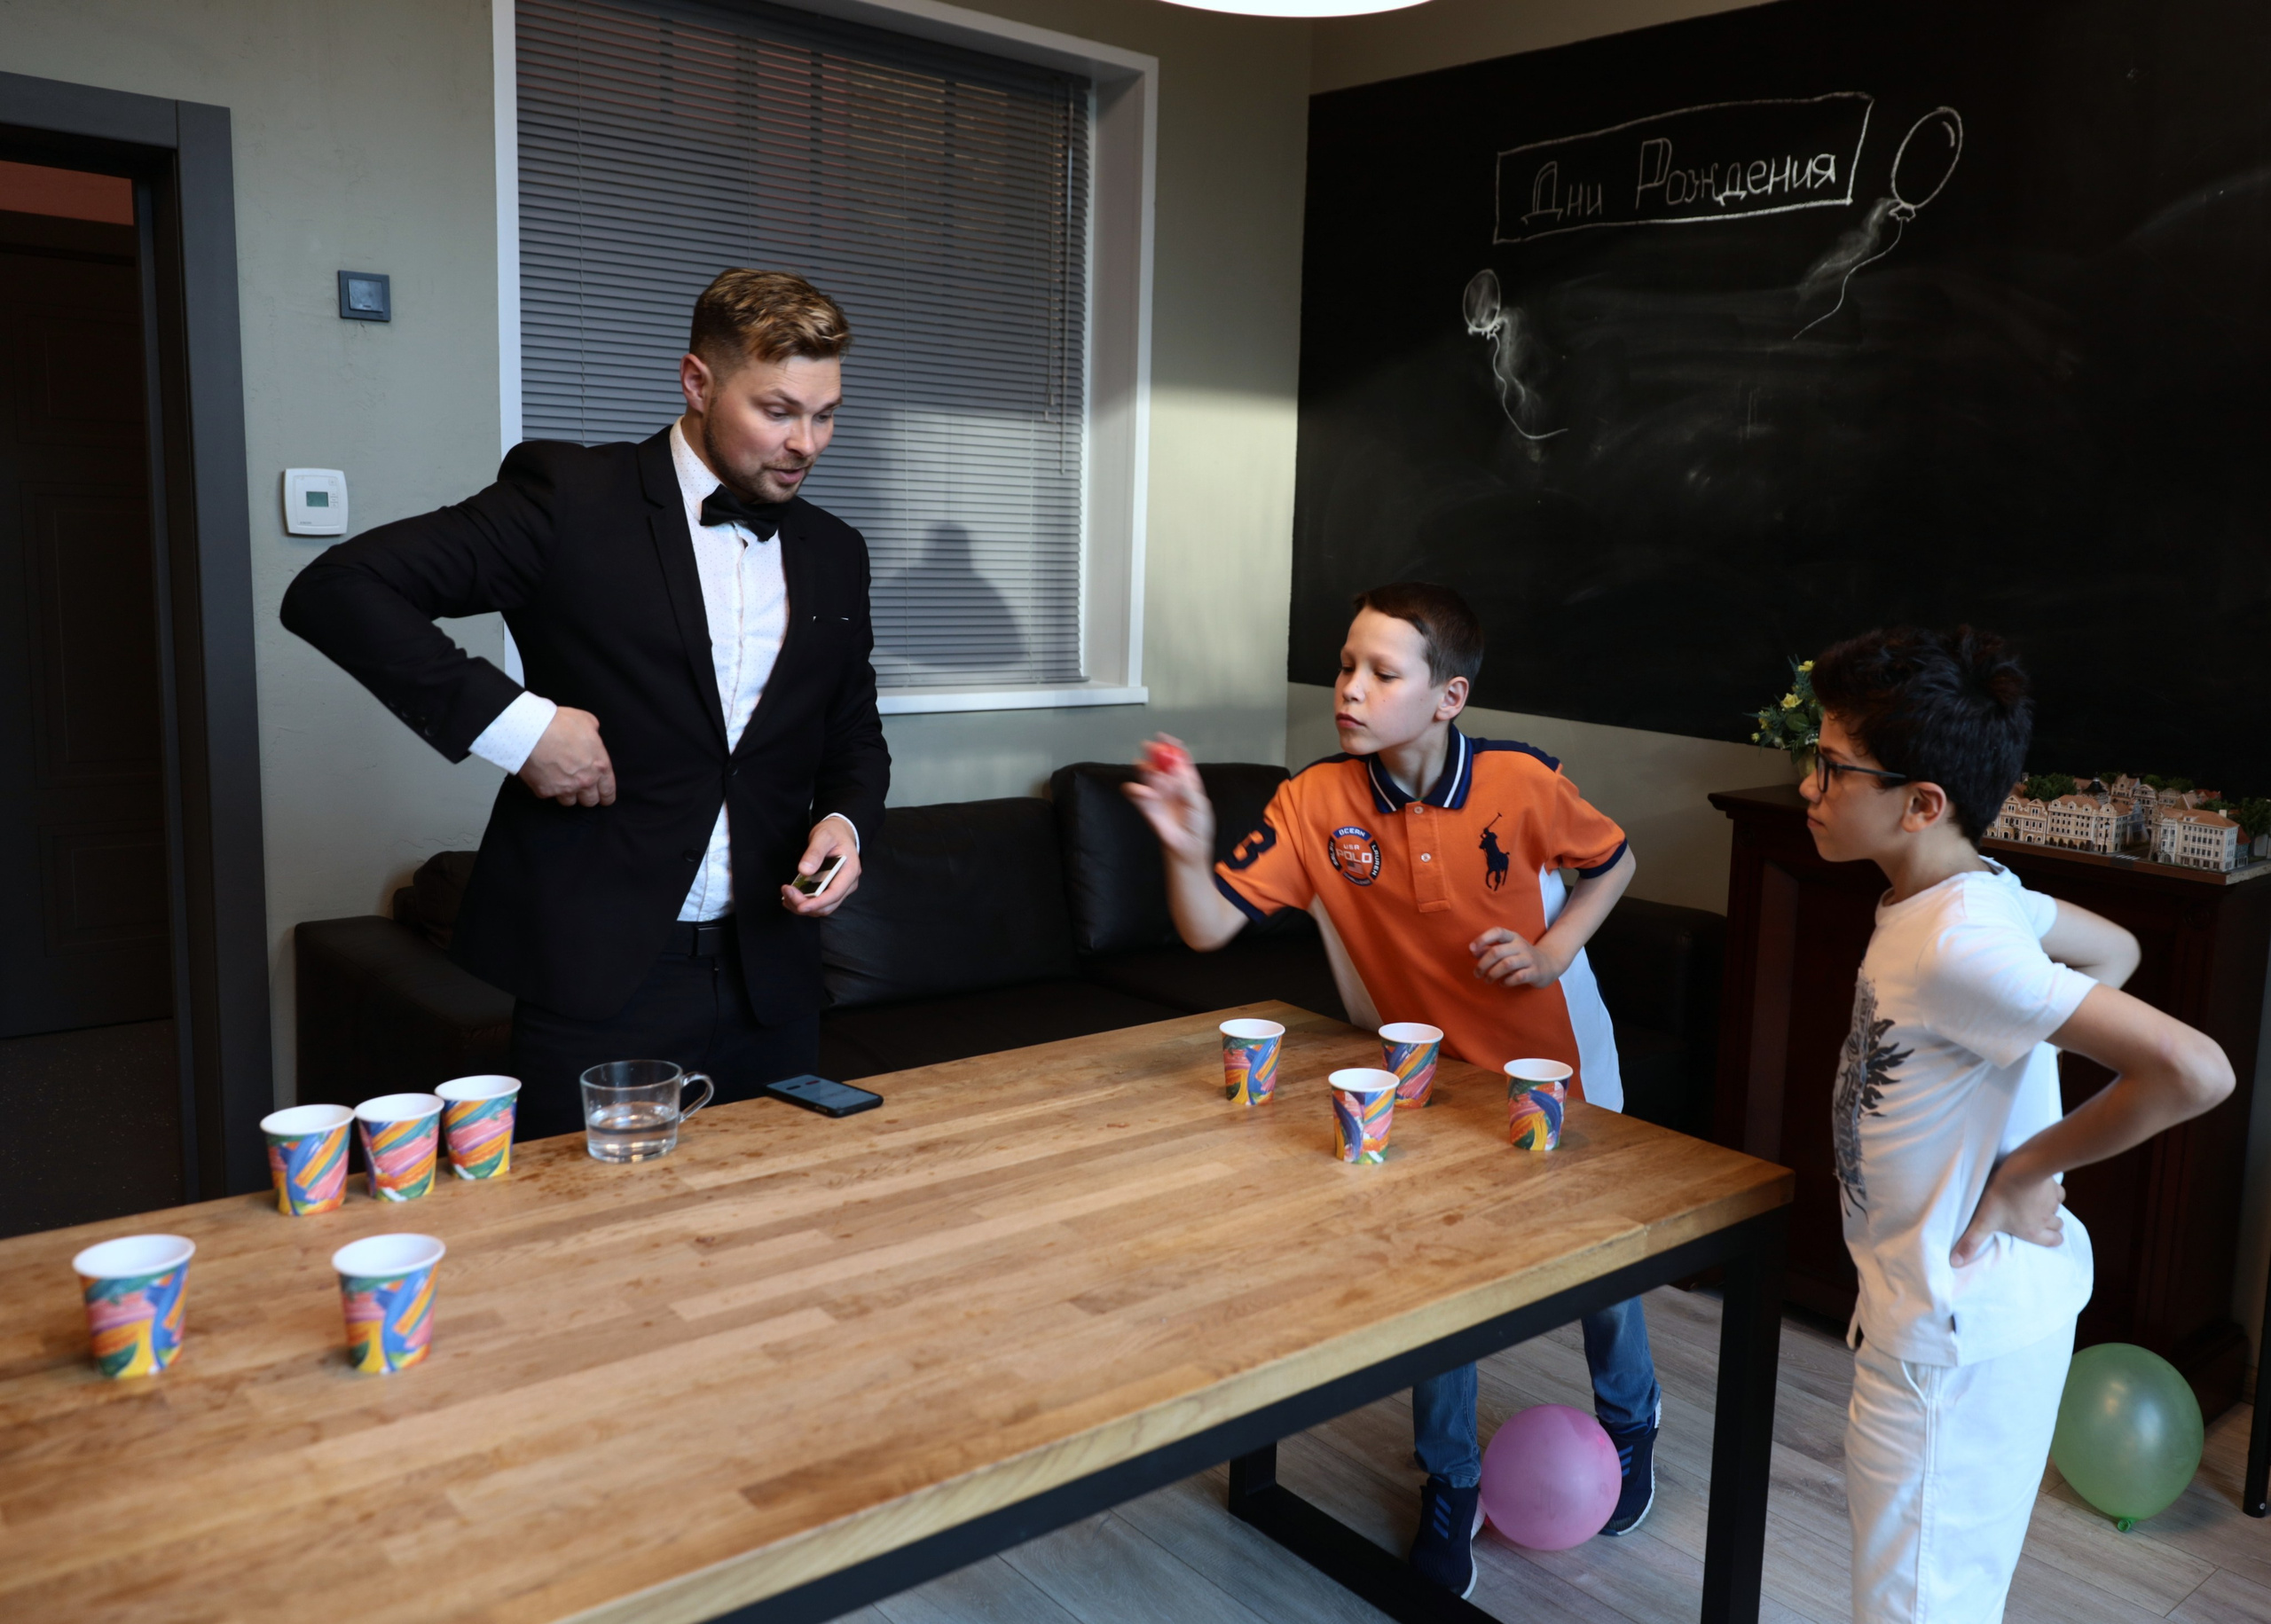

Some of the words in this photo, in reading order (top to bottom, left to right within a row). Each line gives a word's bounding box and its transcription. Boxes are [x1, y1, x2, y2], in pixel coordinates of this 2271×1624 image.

[1521, 161, 1602, 224] Дни
[1635, 137, 1836, 208] Рождения
[1338, 827, 1366, 837] OCEAN
[1335, 849, 1372, 863] POLO
[1371, 844, 1380, 876] LAUREN
